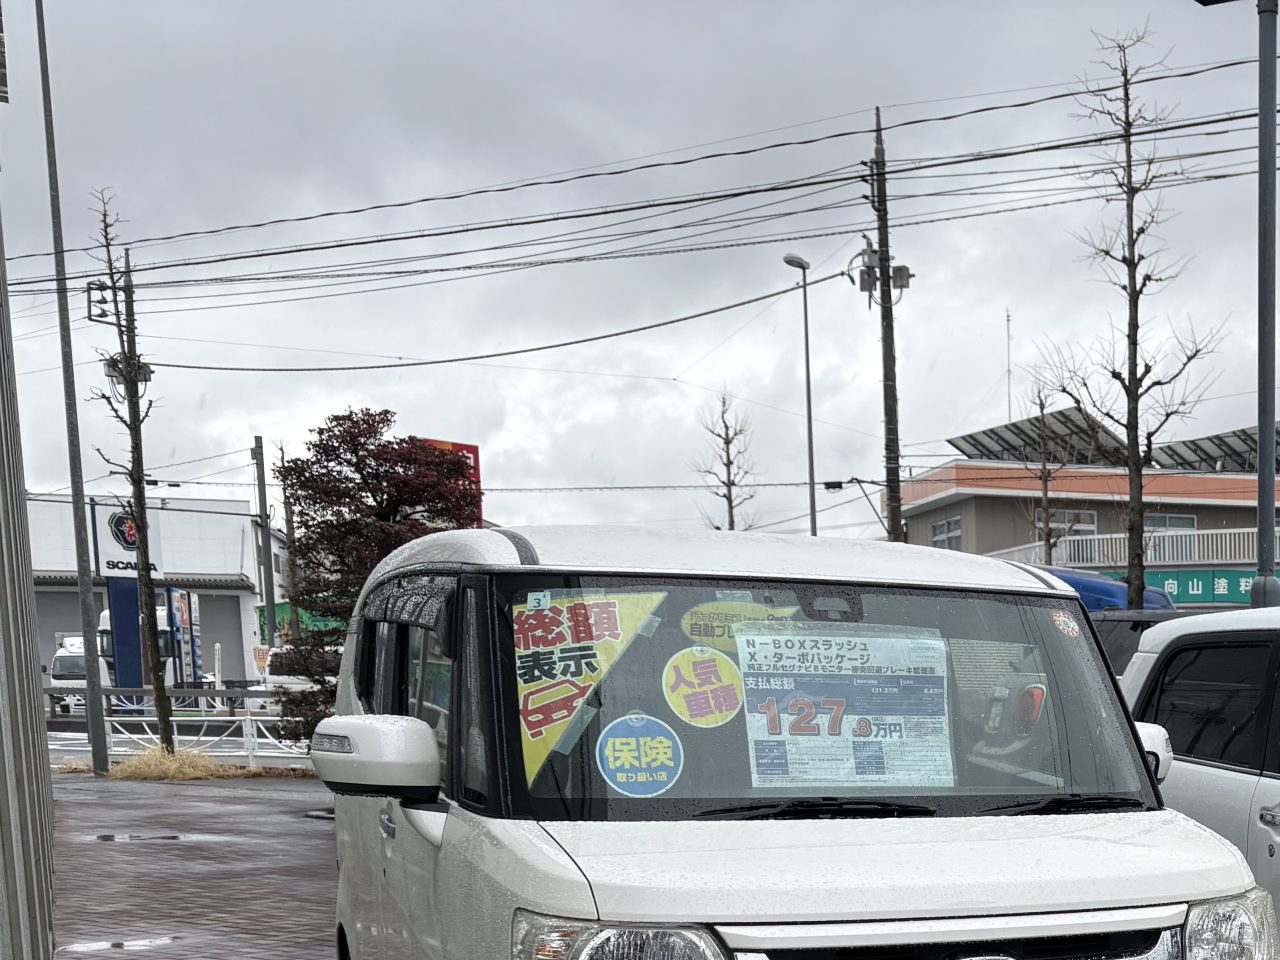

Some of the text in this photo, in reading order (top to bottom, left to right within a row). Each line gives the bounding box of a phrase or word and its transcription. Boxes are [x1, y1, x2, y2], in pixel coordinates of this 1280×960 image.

[105, 560, 158, 572] SCAA
[514, 601, 622, 649] 総額
[516, 646, 599, 684] 表示
[670, 657, 723, 693] 人気
[683, 683, 740, 718] 車種
[744, 676, 795, 690] 支払総額
[604, 735, 675, 770] 保険
